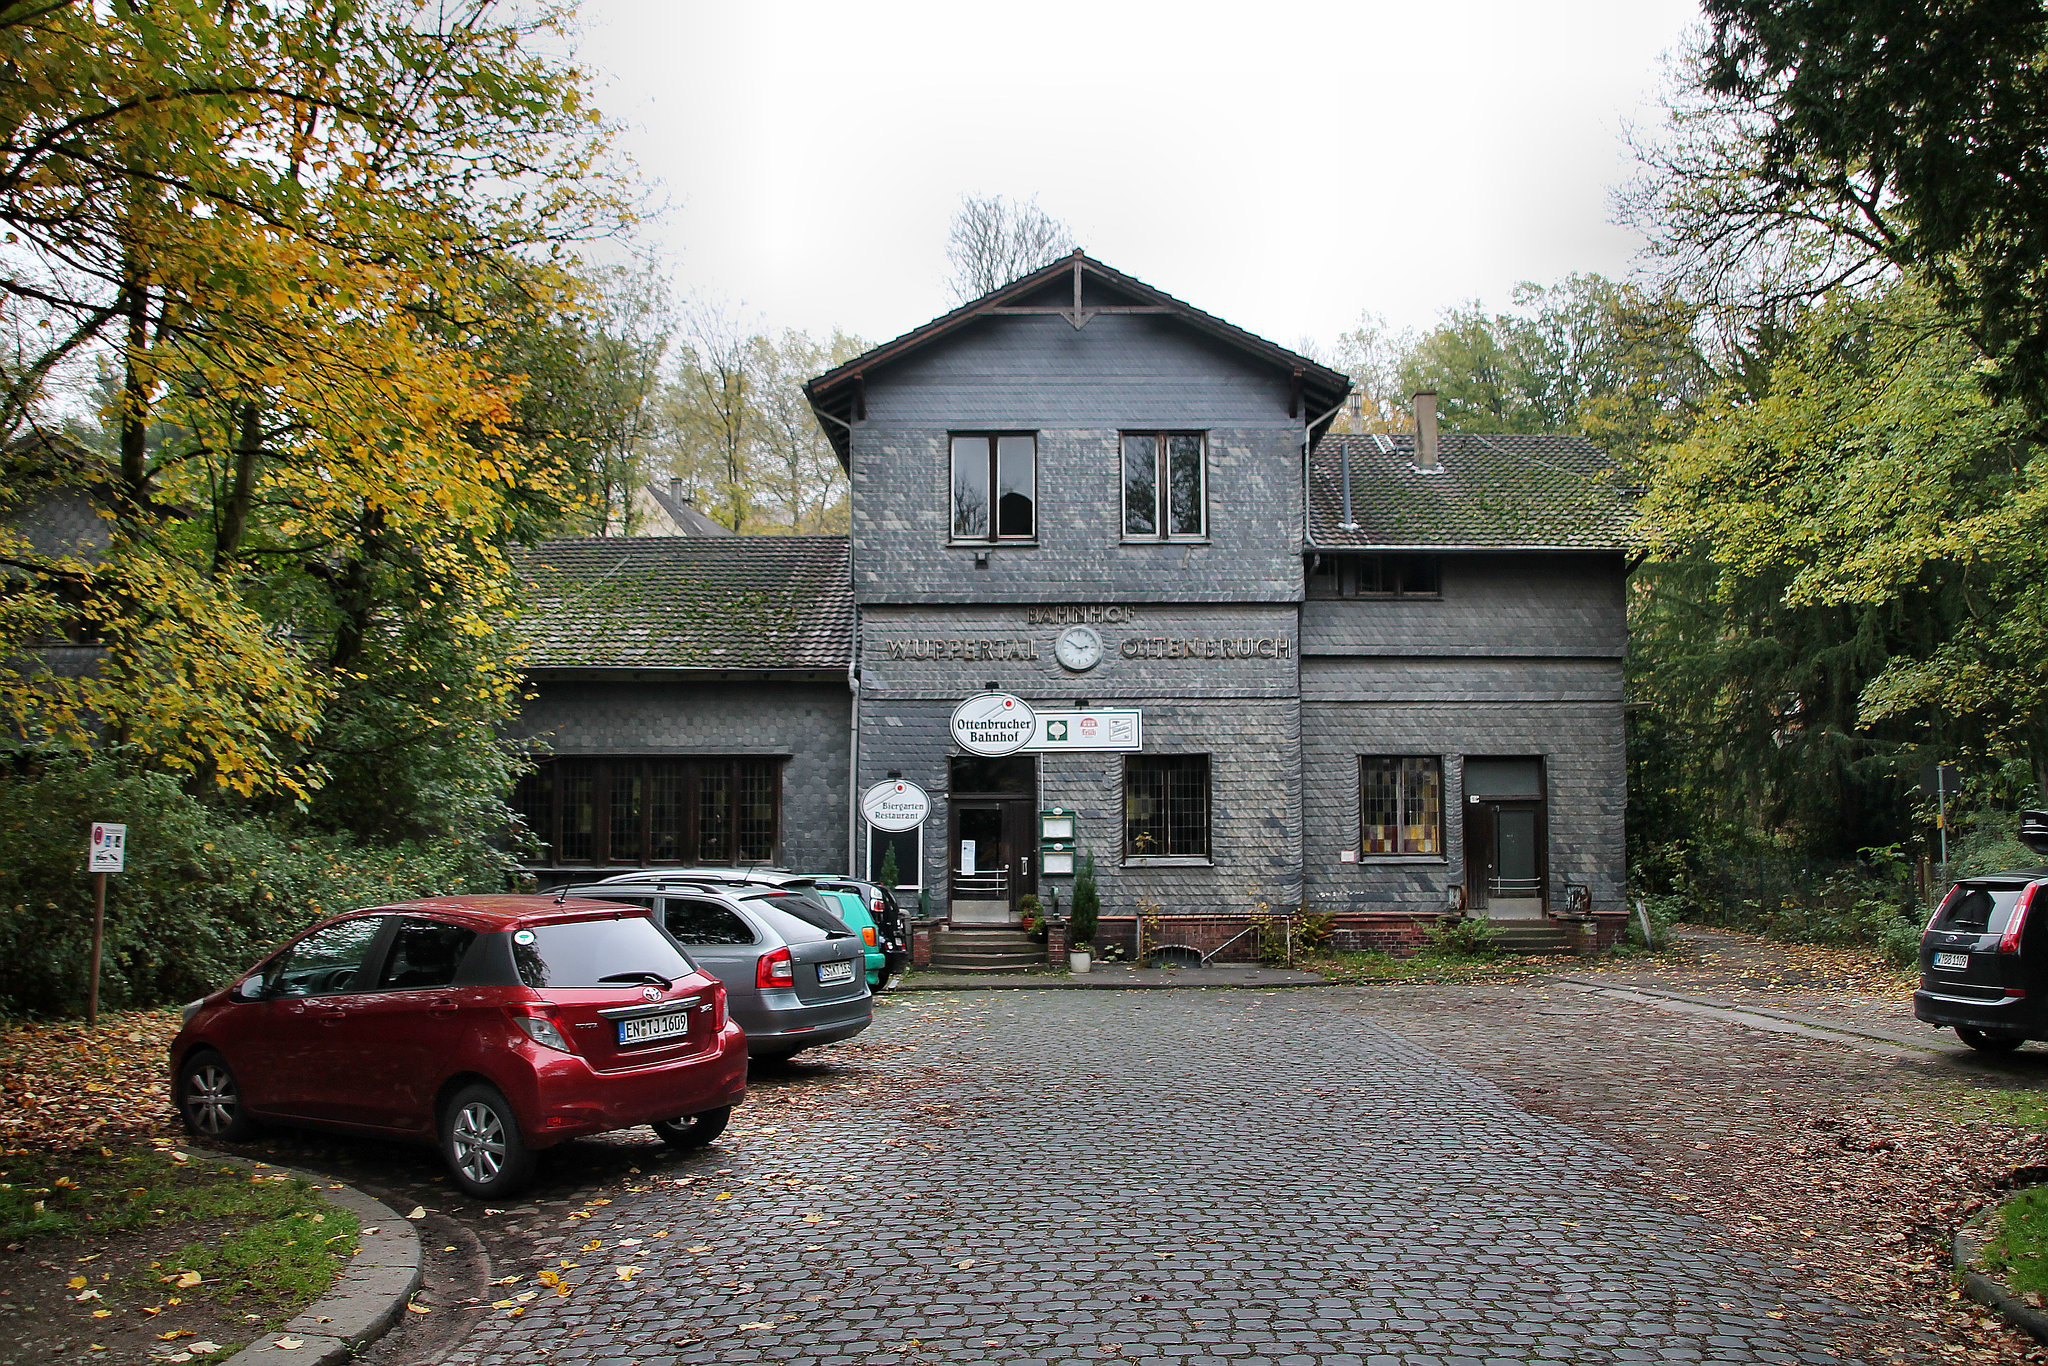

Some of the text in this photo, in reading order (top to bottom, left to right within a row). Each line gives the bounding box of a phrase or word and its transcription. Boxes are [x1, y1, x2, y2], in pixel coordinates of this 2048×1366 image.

[1028, 606, 1135, 624] BAHNHOF
[887, 638, 1292, 660] WUPPERTAL OTTENBRUCH
[957, 719, 1031, 730] Ottenbrucher
[970, 731, 1019, 742] Bahnhof
[882, 803, 924, 811] Biergarten
[875, 812, 918, 820] Restaurant
[626, 1014, 687, 1038] EN TJ 1609
